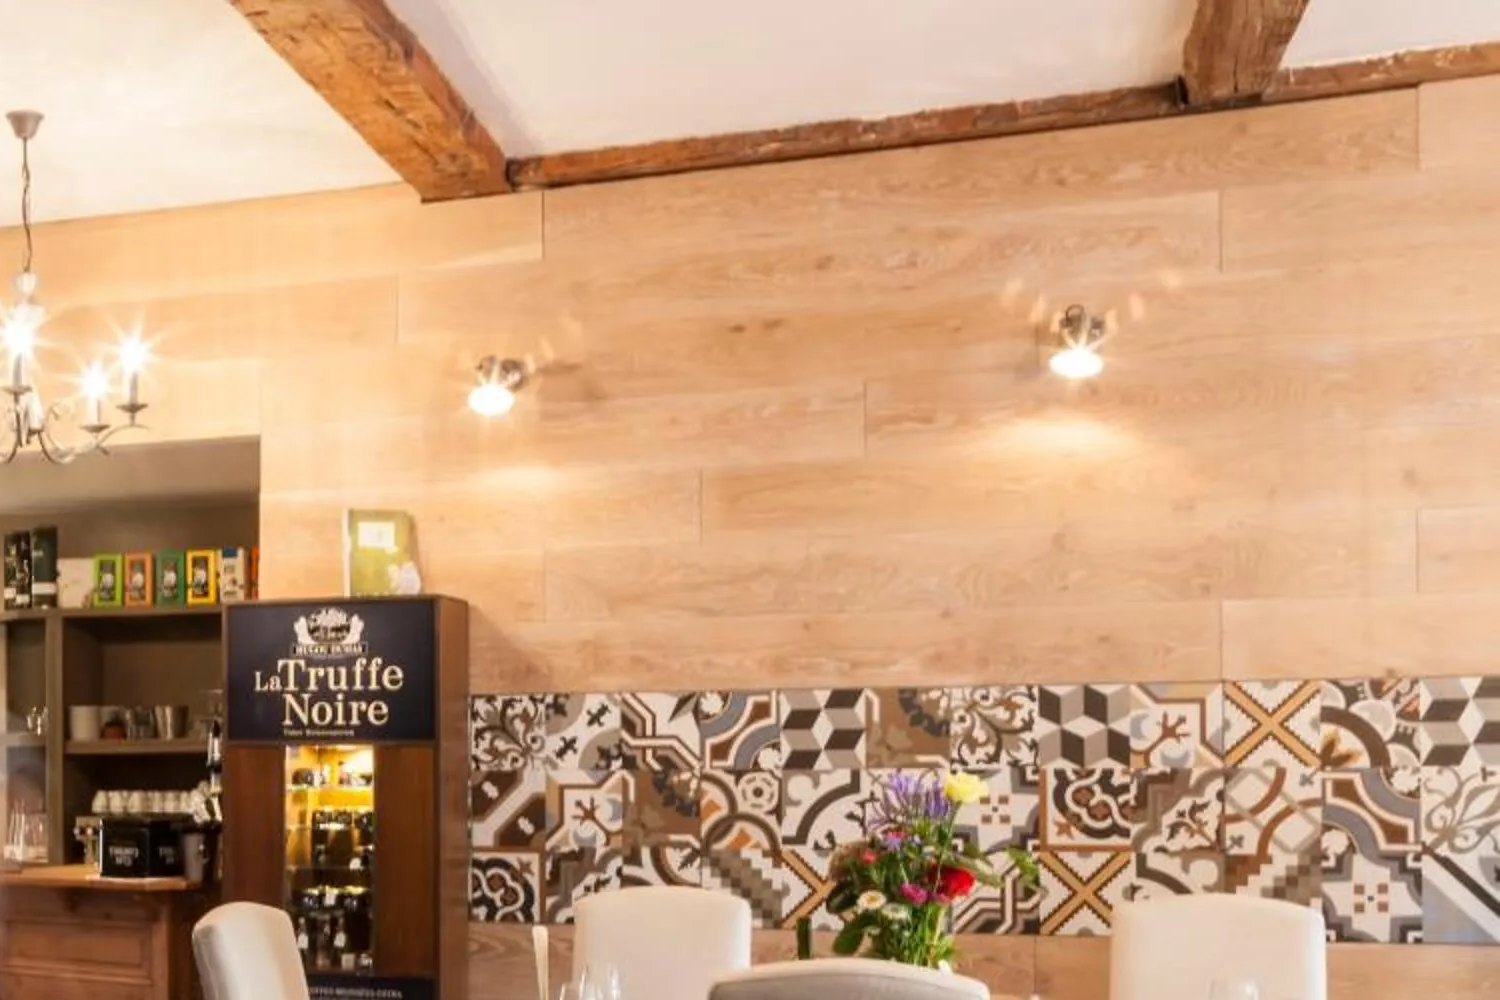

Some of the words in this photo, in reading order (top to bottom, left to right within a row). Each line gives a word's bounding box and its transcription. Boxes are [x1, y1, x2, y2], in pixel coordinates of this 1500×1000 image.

[254, 671, 281, 692] La
[277, 657, 404, 692] Truffe
[282, 693, 389, 727] Noire
